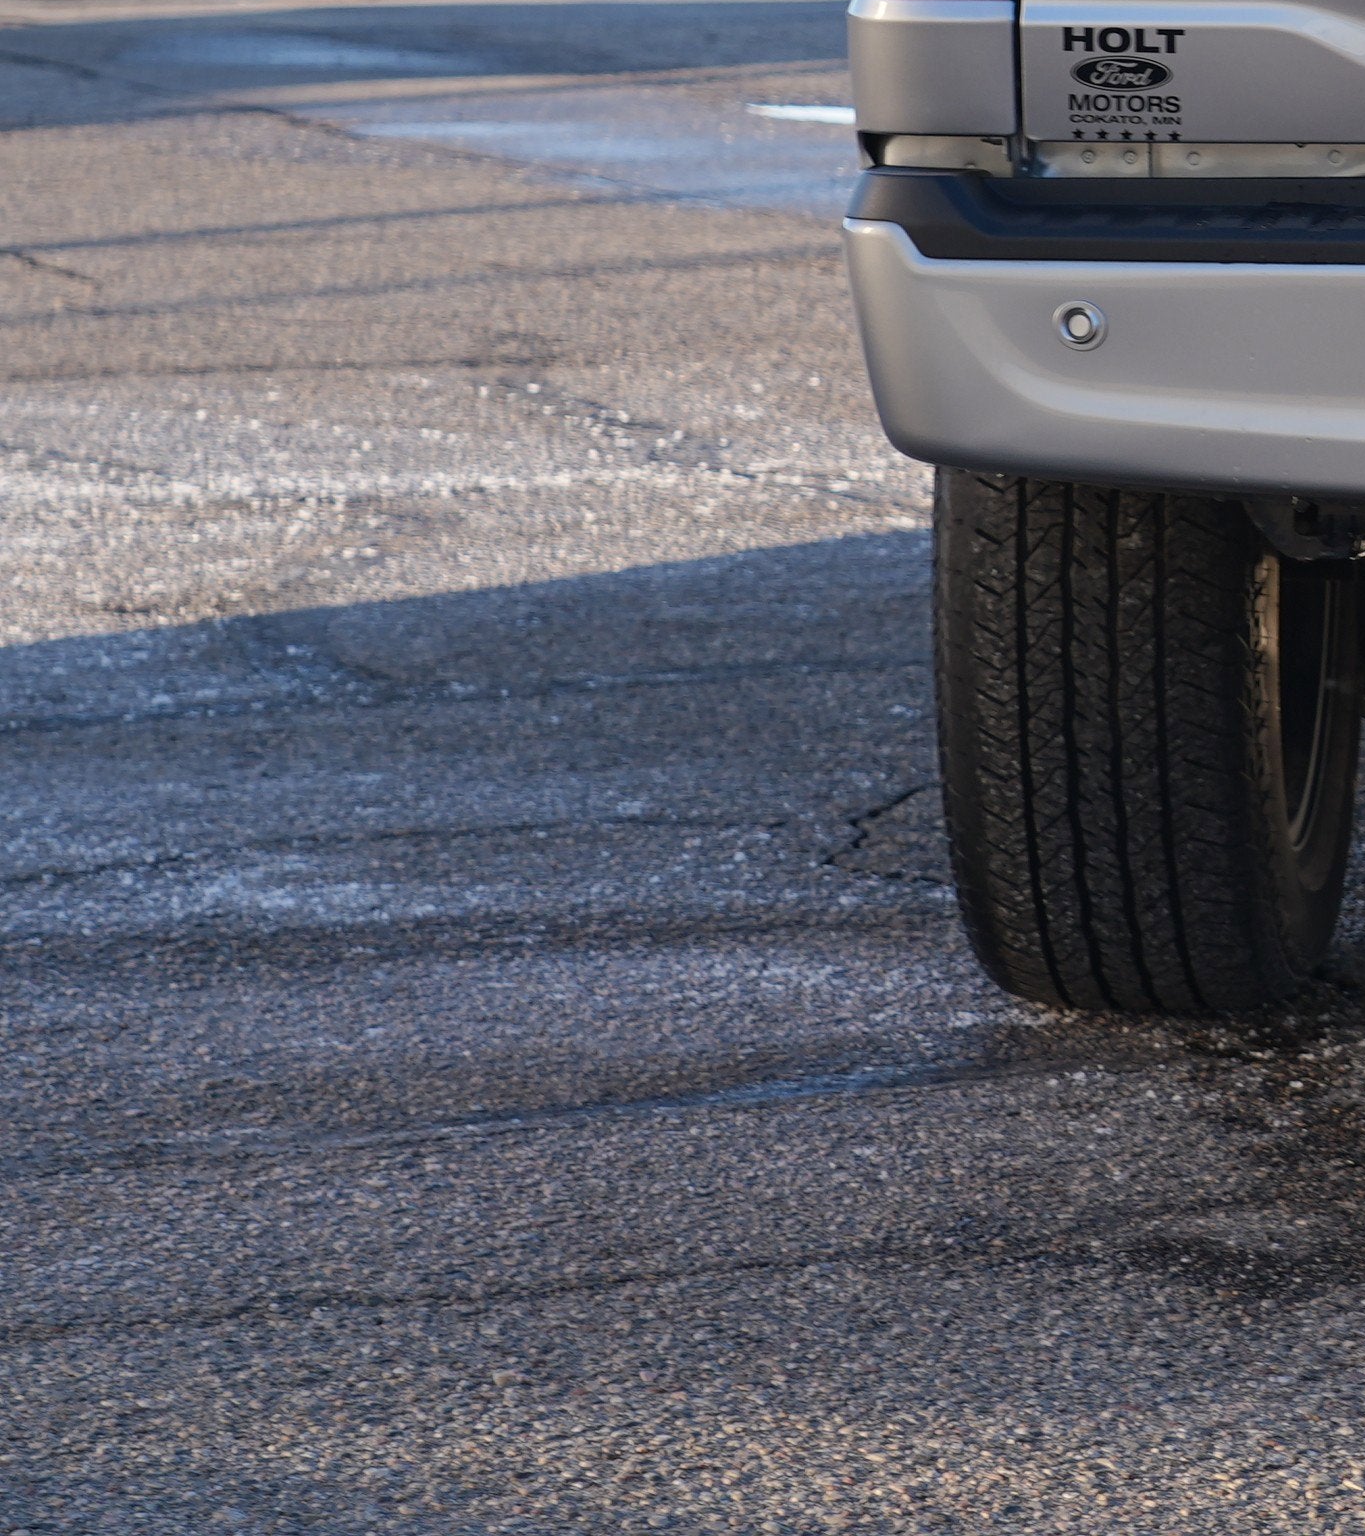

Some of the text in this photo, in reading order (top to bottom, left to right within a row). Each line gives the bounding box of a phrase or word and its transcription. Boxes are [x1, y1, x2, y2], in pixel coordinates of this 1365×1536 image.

[1063, 26, 1185, 53] HOLT
[1089, 60, 1154, 85] Ford
[1068, 94, 1180, 113] MOTORS
[1152, 116, 1182, 125] MN
